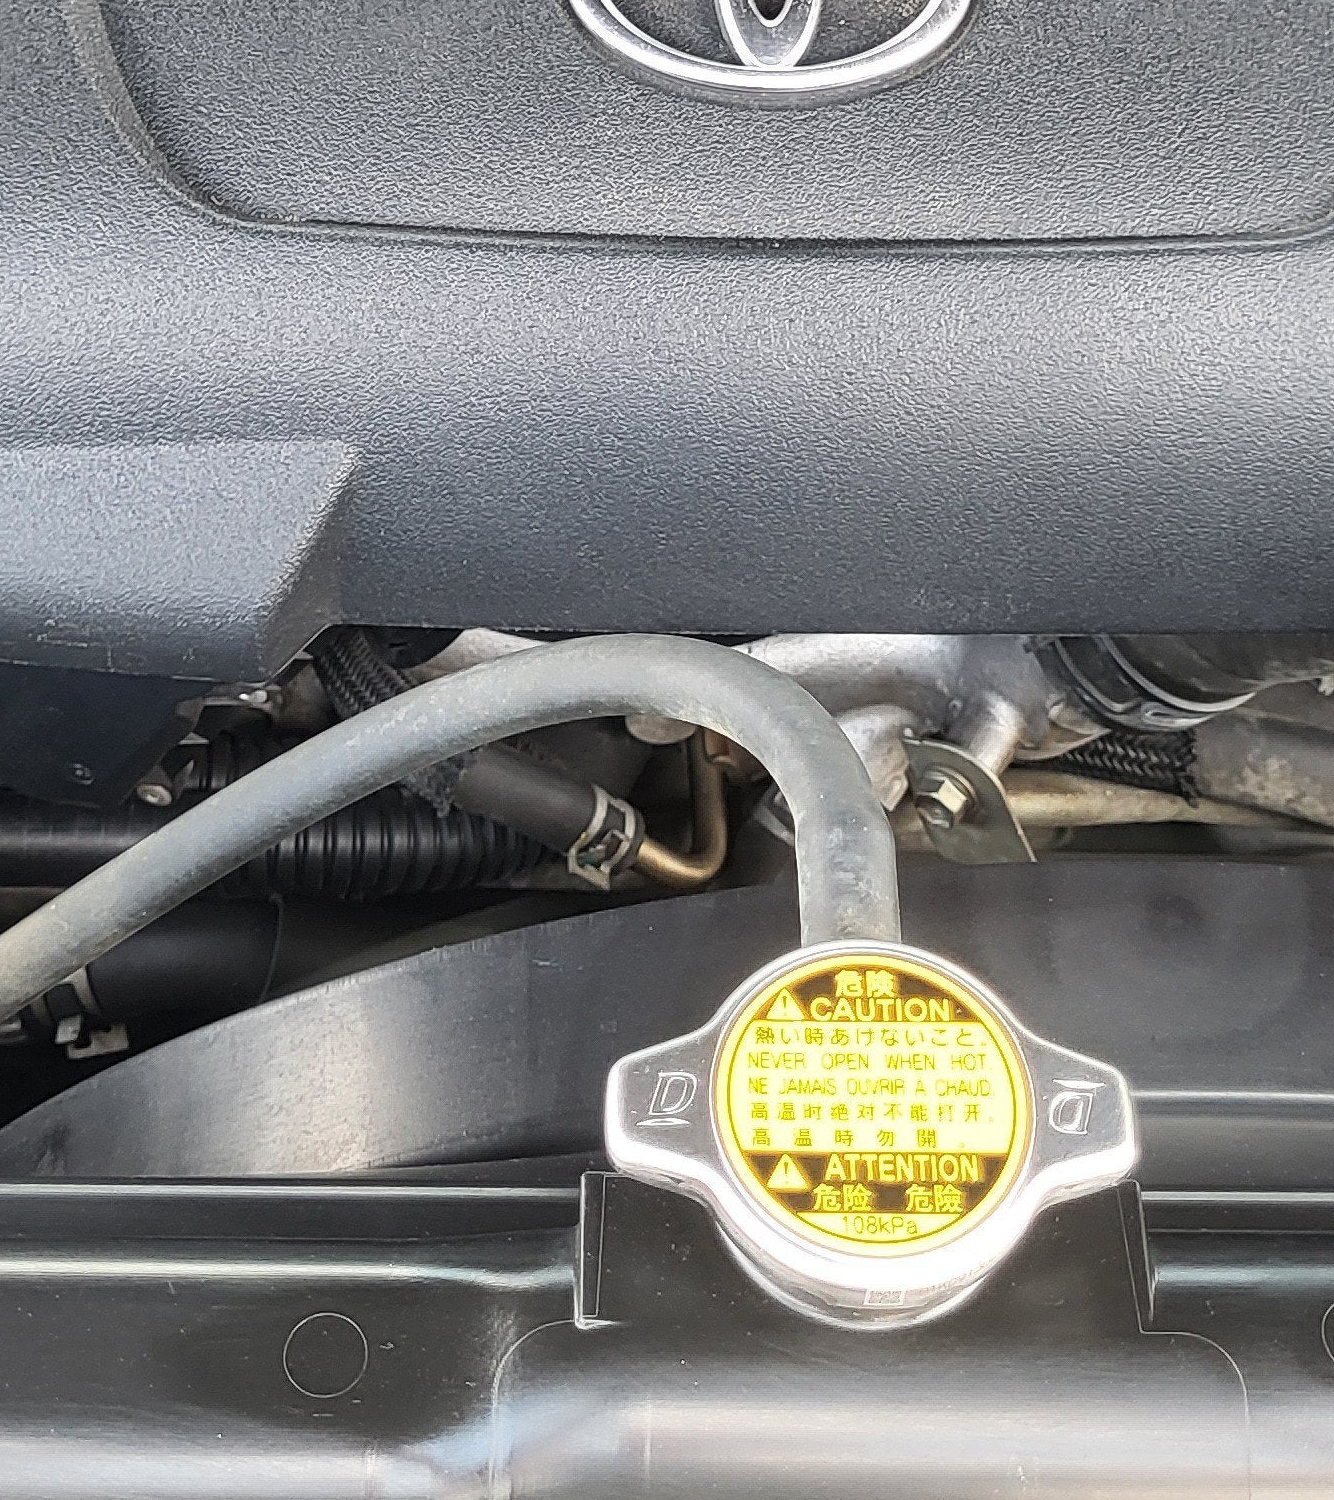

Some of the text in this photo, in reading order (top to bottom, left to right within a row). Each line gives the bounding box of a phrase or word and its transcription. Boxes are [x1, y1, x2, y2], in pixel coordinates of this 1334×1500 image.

[809, 996, 950, 1022] CAUTION
[748, 1052, 805, 1070] NEVER
[821, 1052, 869, 1070] OPEN
[885, 1052, 935, 1070] WHEN
[748, 1077, 768, 1096] NE
[779, 1078, 837, 1096] JAMAIS
[846, 1078, 905, 1096] OUVRIR
[824, 1153, 980, 1182] ATTENTION
[841, 1216, 919, 1236] 108kPa
